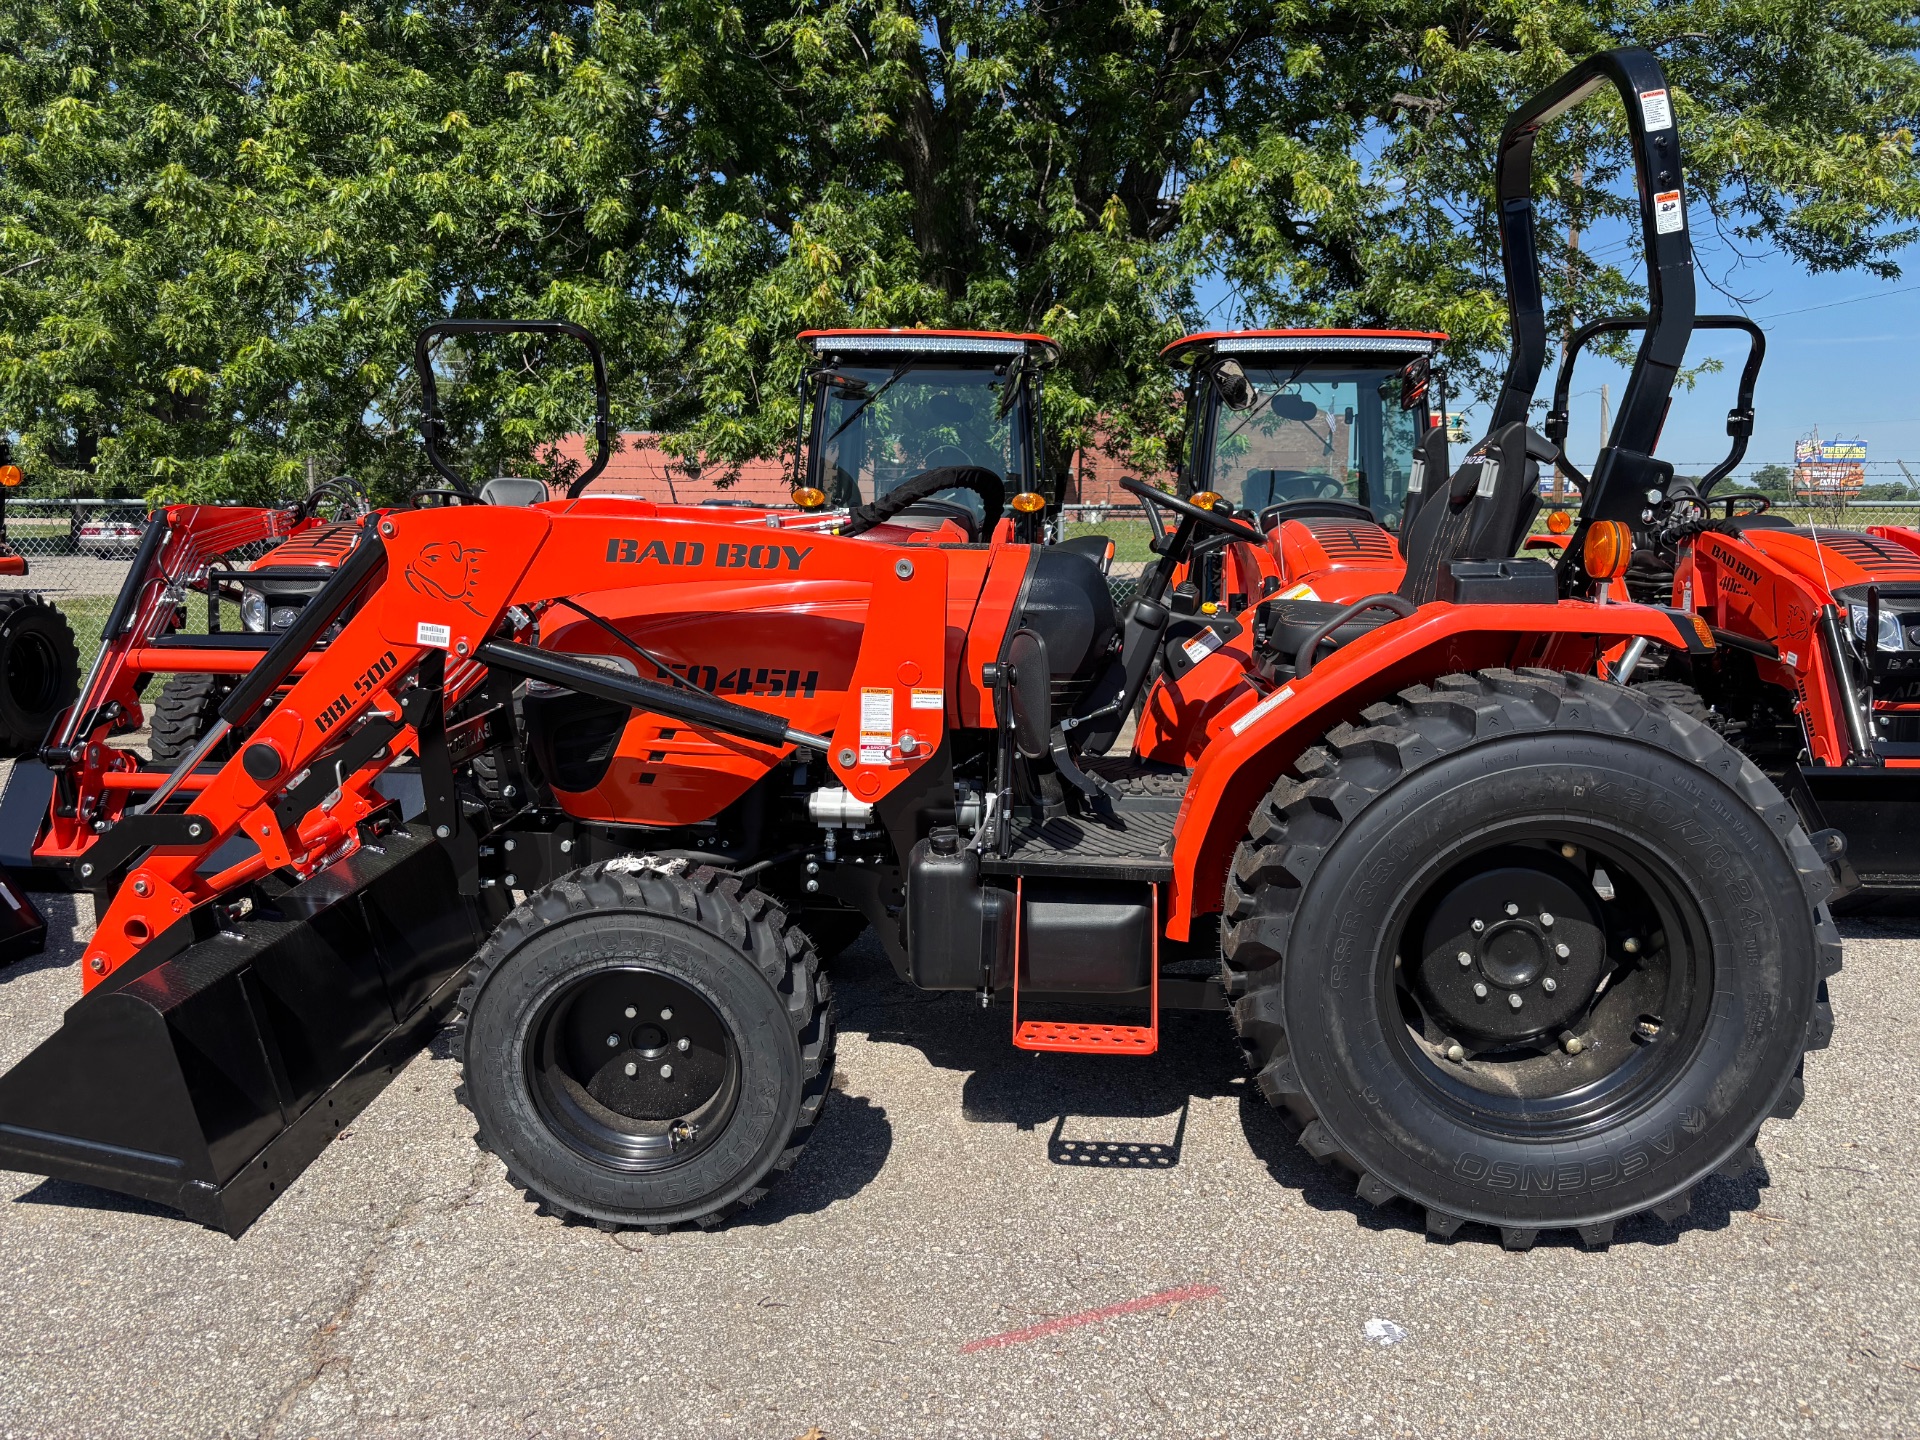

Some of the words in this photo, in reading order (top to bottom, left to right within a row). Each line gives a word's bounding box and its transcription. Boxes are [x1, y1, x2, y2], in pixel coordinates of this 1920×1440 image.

[605, 538, 705, 566] BAD
[715, 542, 814, 570] BOY
[1711, 544, 1736, 569] BAD
[1735, 561, 1762, 586] BOY
[314, 693, 357, 734] BBL
[353, 650, 398, 697] 500
[656, 663, 819, 699] 5045H
[1594, 780, 1764, 931] 420/70-24
[1330, 910, 1367, 989] SSB
[1353, 842, 1411, 908] 331
[661, 1097, 777, 1205] ASCENSO
[1452, 1118, 1677, 1191] ASCENSO
